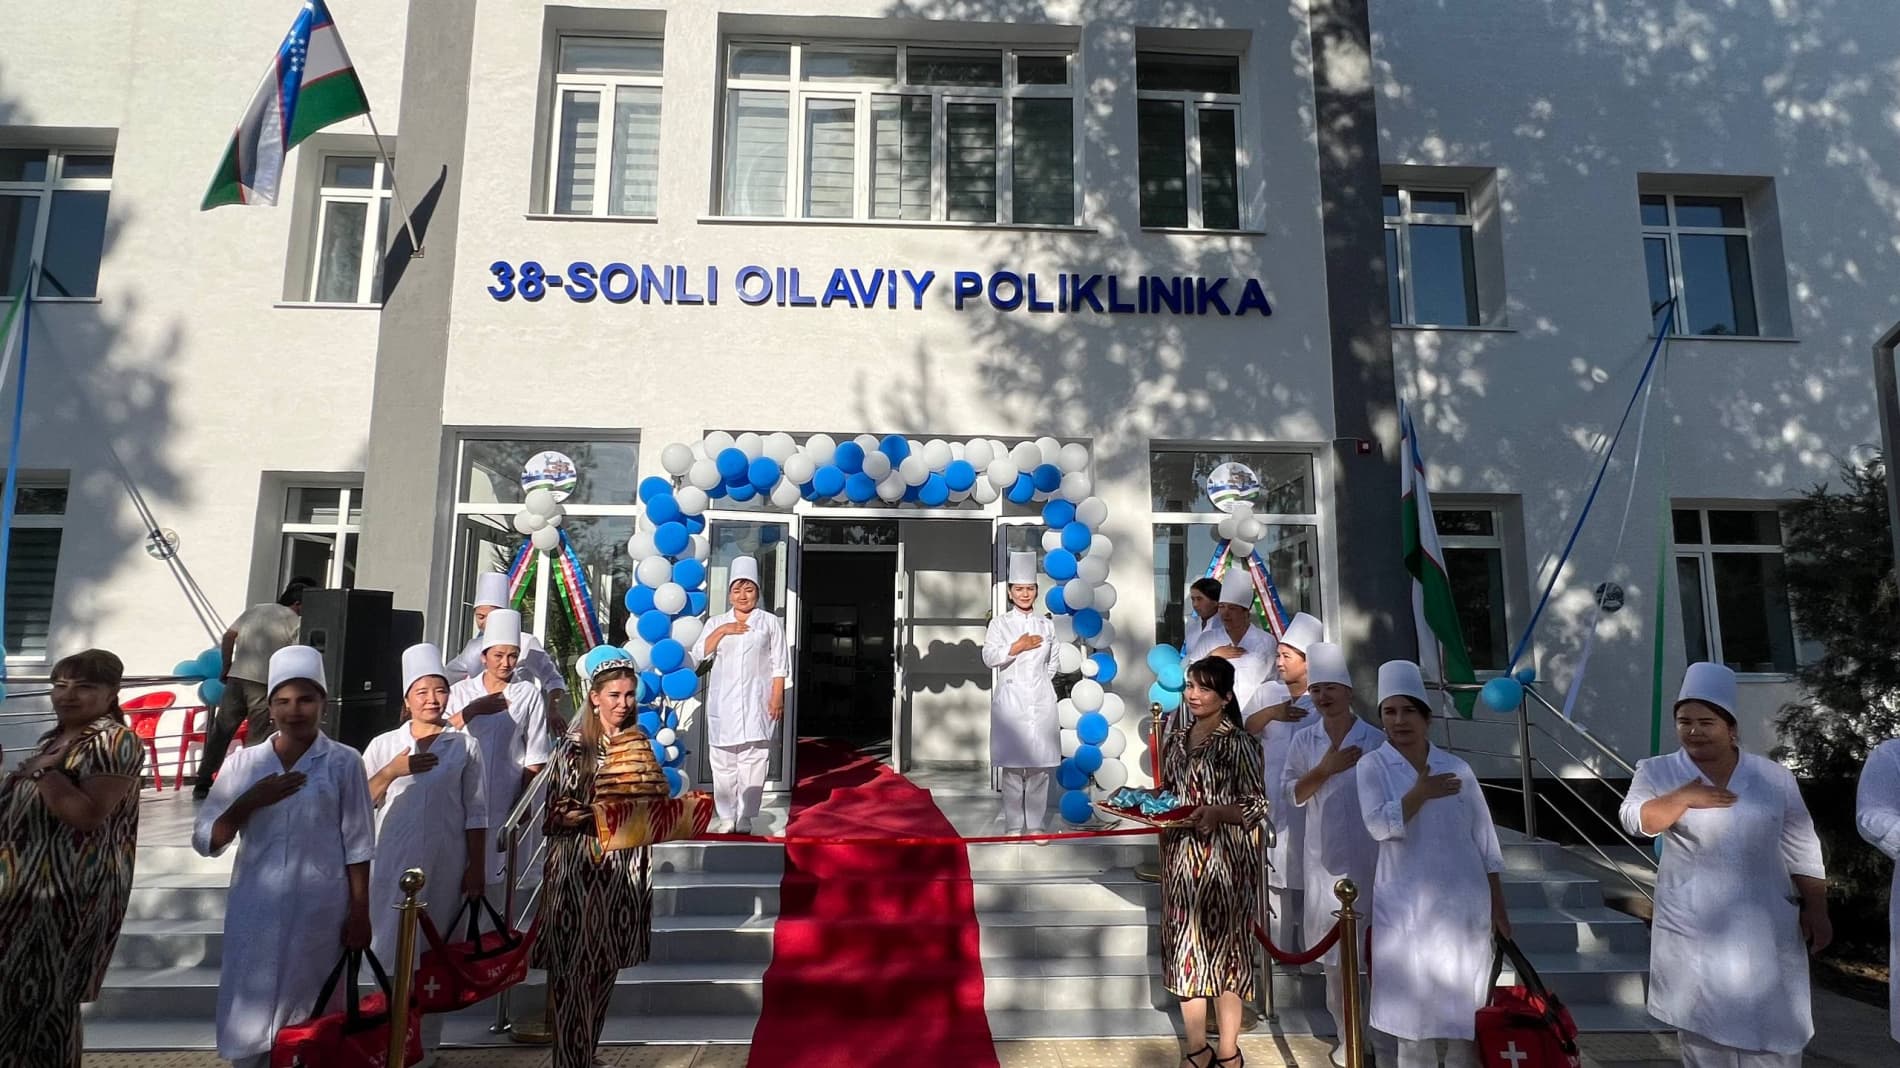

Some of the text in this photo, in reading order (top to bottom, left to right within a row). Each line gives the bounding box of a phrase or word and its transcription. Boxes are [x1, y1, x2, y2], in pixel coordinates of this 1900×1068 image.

[488, 260, 1273, 317] 38-SONLI OILAVIY POLIKLINIKA
